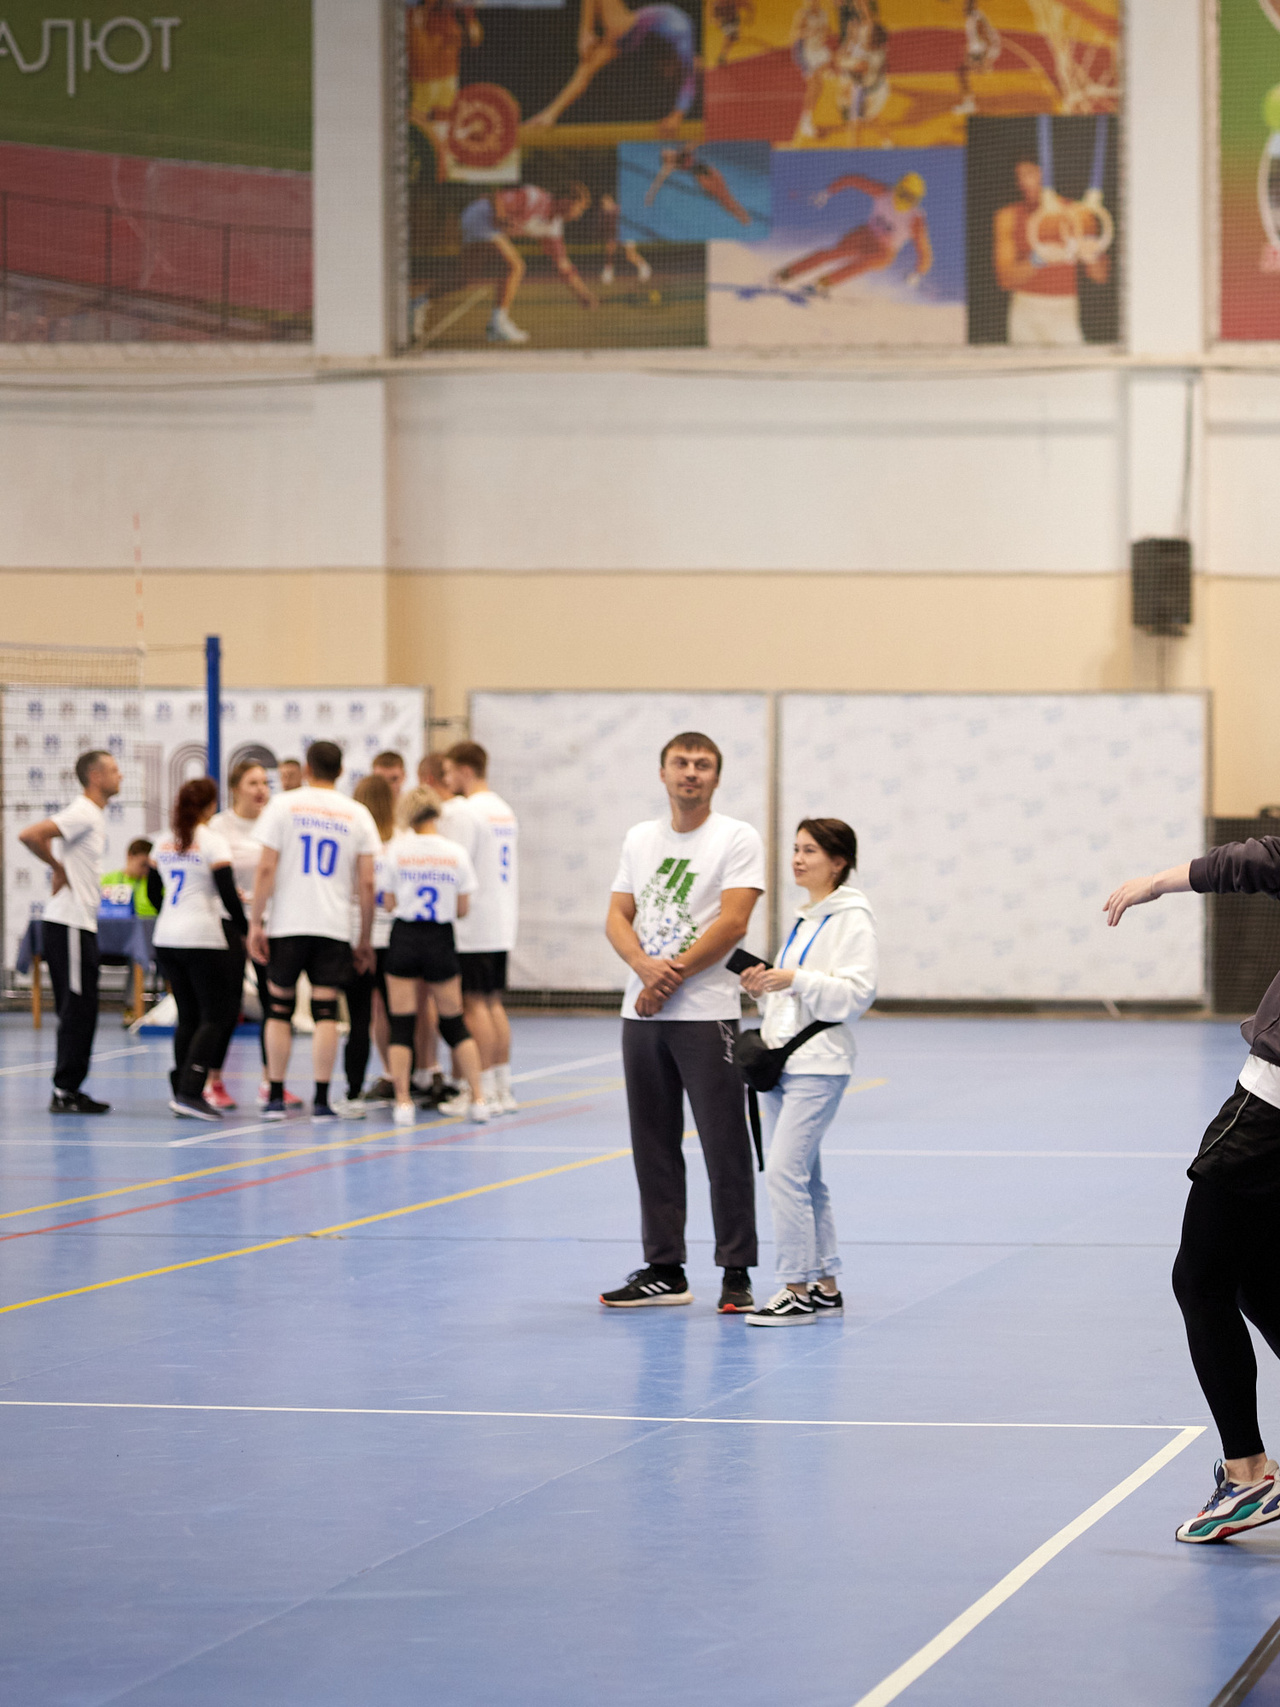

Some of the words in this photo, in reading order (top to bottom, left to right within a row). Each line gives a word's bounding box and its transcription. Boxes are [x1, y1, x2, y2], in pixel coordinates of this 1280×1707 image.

[300, 834, 339, 877] 10
[170, 869, 185, 905] 7
[415, 886, 439, 921] 3
